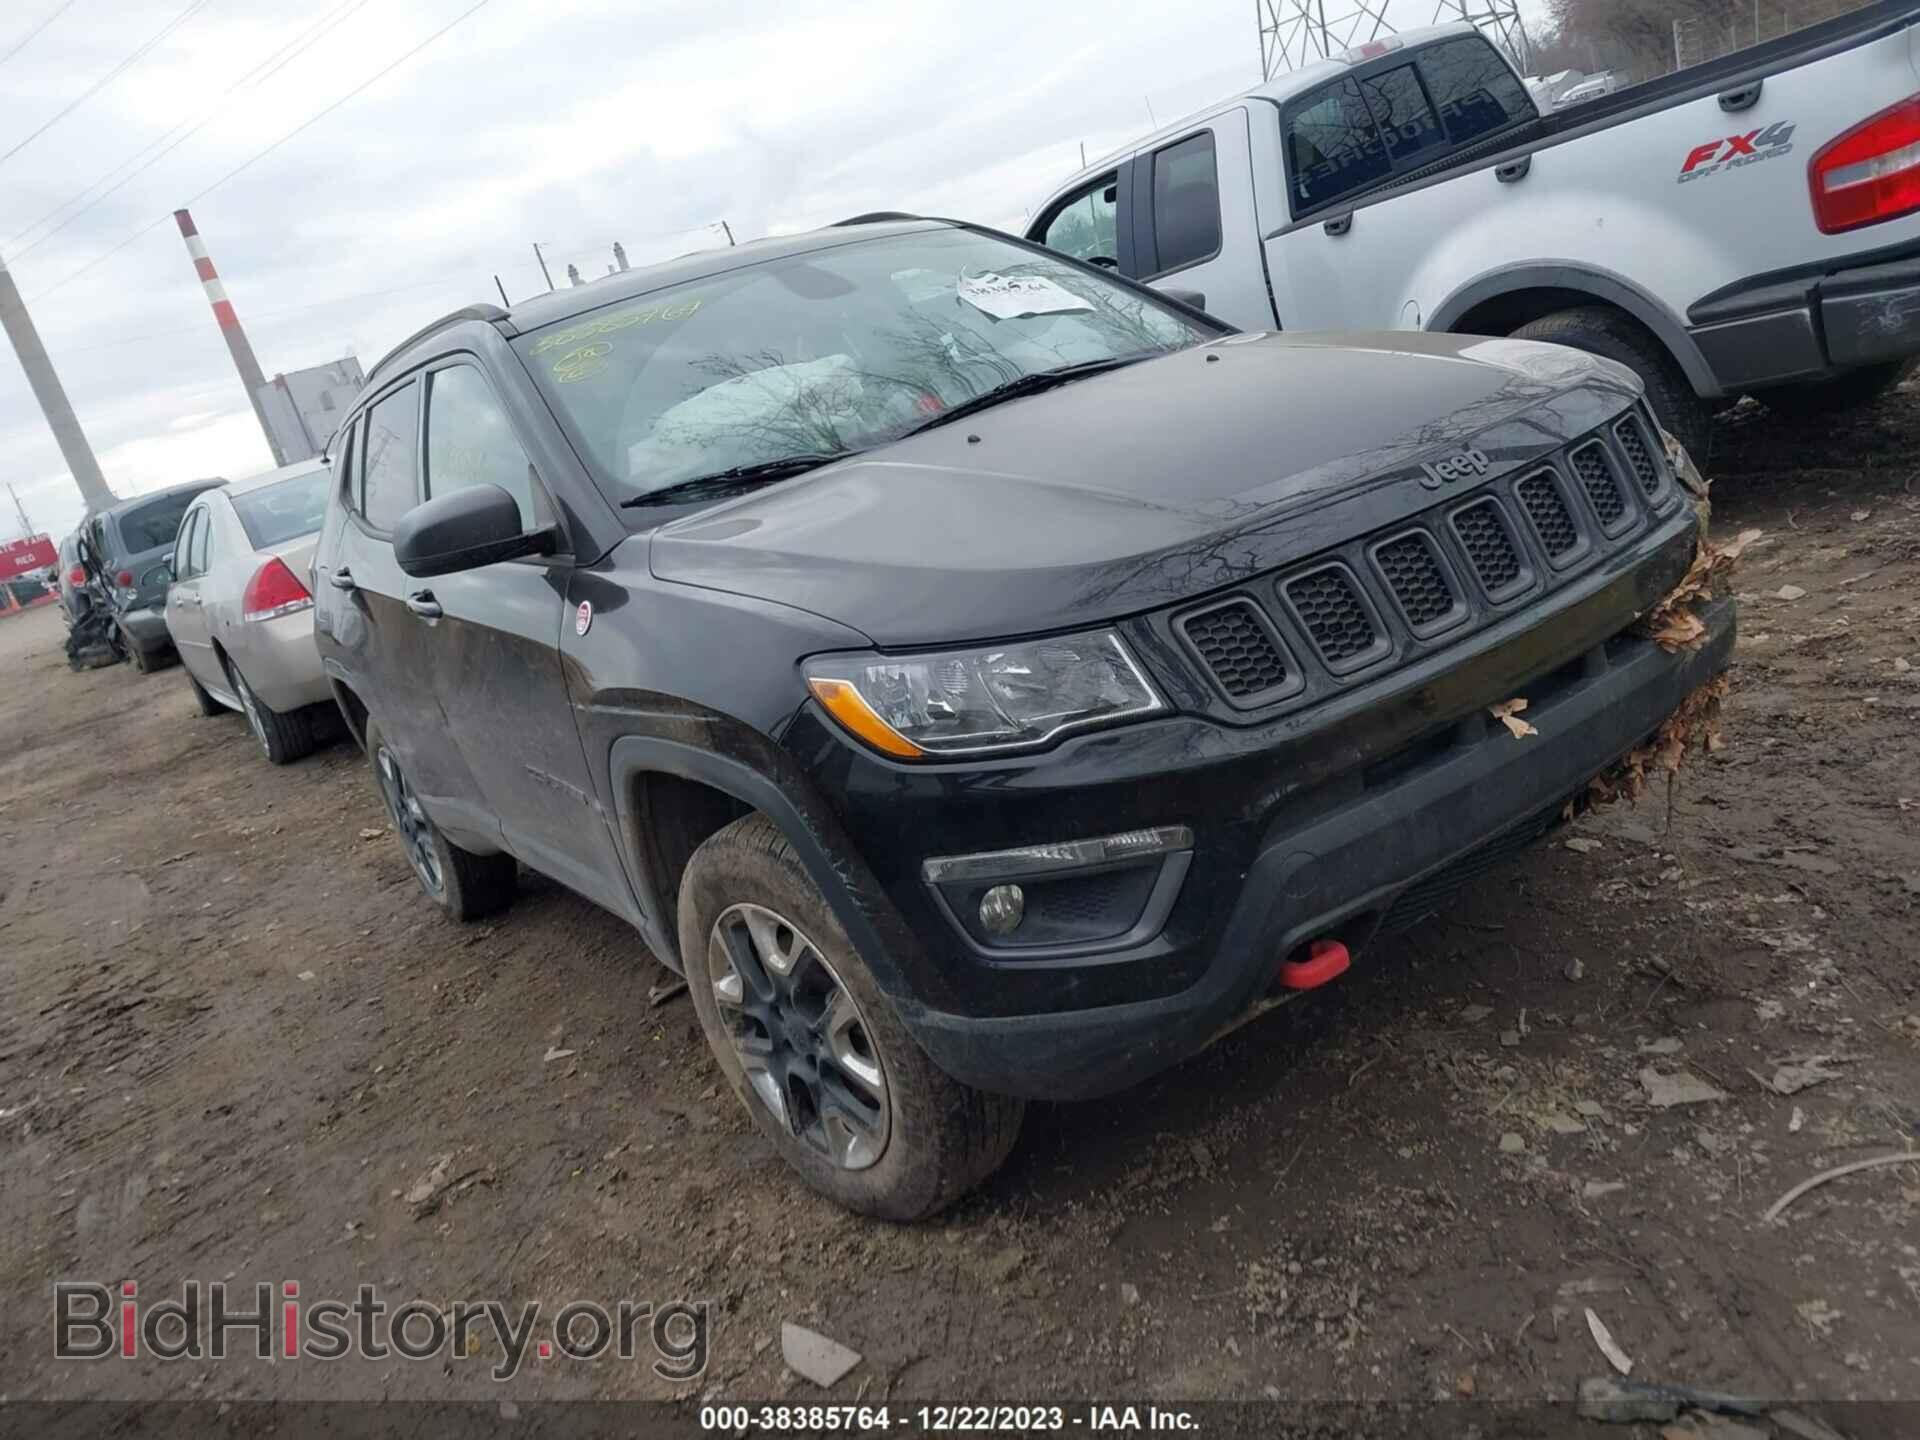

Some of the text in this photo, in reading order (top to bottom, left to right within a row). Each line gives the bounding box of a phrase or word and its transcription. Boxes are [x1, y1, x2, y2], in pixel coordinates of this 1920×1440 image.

[1677, 142, 1793, 184] OFF ROAD
[1680, 119, 1797, 174] FX4
[1418, 449, 1489, 491] Jeep
